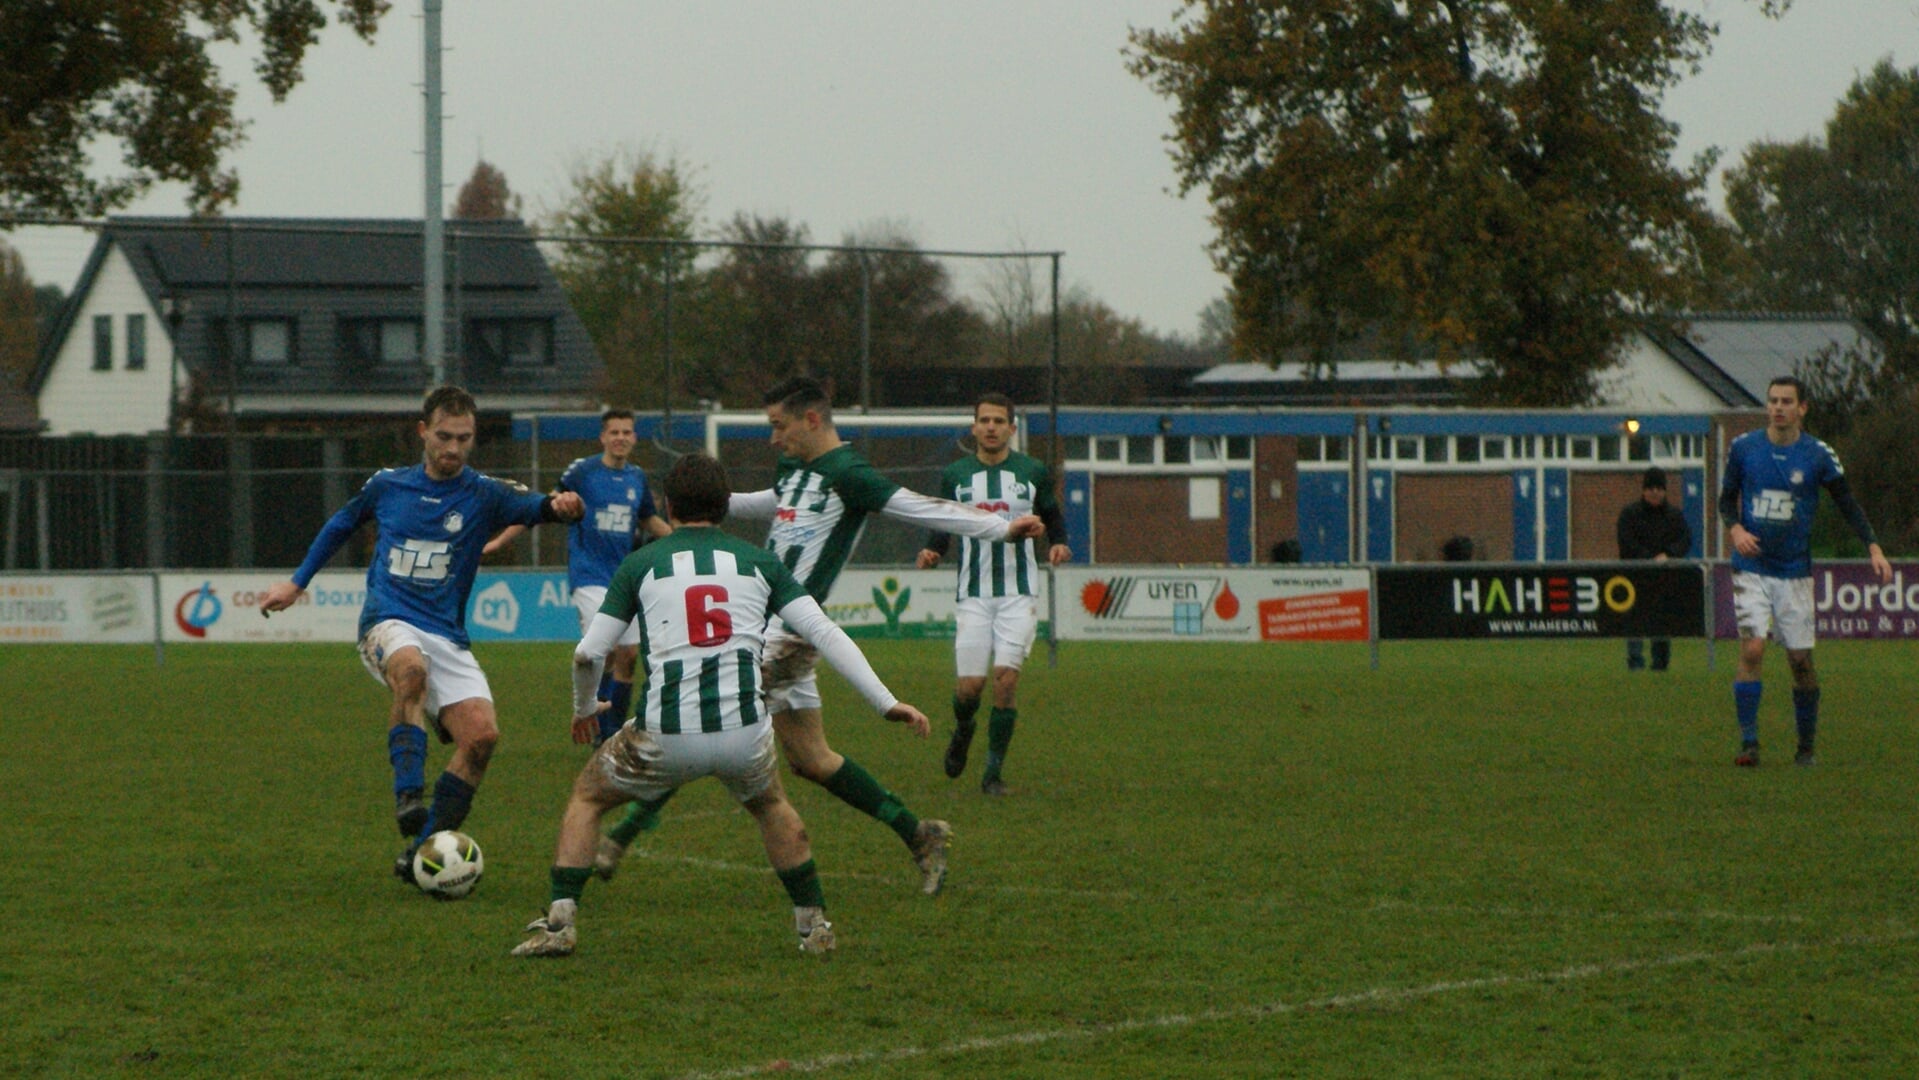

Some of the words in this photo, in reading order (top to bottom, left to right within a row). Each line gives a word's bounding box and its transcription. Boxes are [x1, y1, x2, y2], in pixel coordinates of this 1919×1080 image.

[1453, 576, 1636, 613] HAHEBO
[684, 584, 733, 648] 6
[1488, 619, 1599, 632] WWW.HAHEBO.NL
